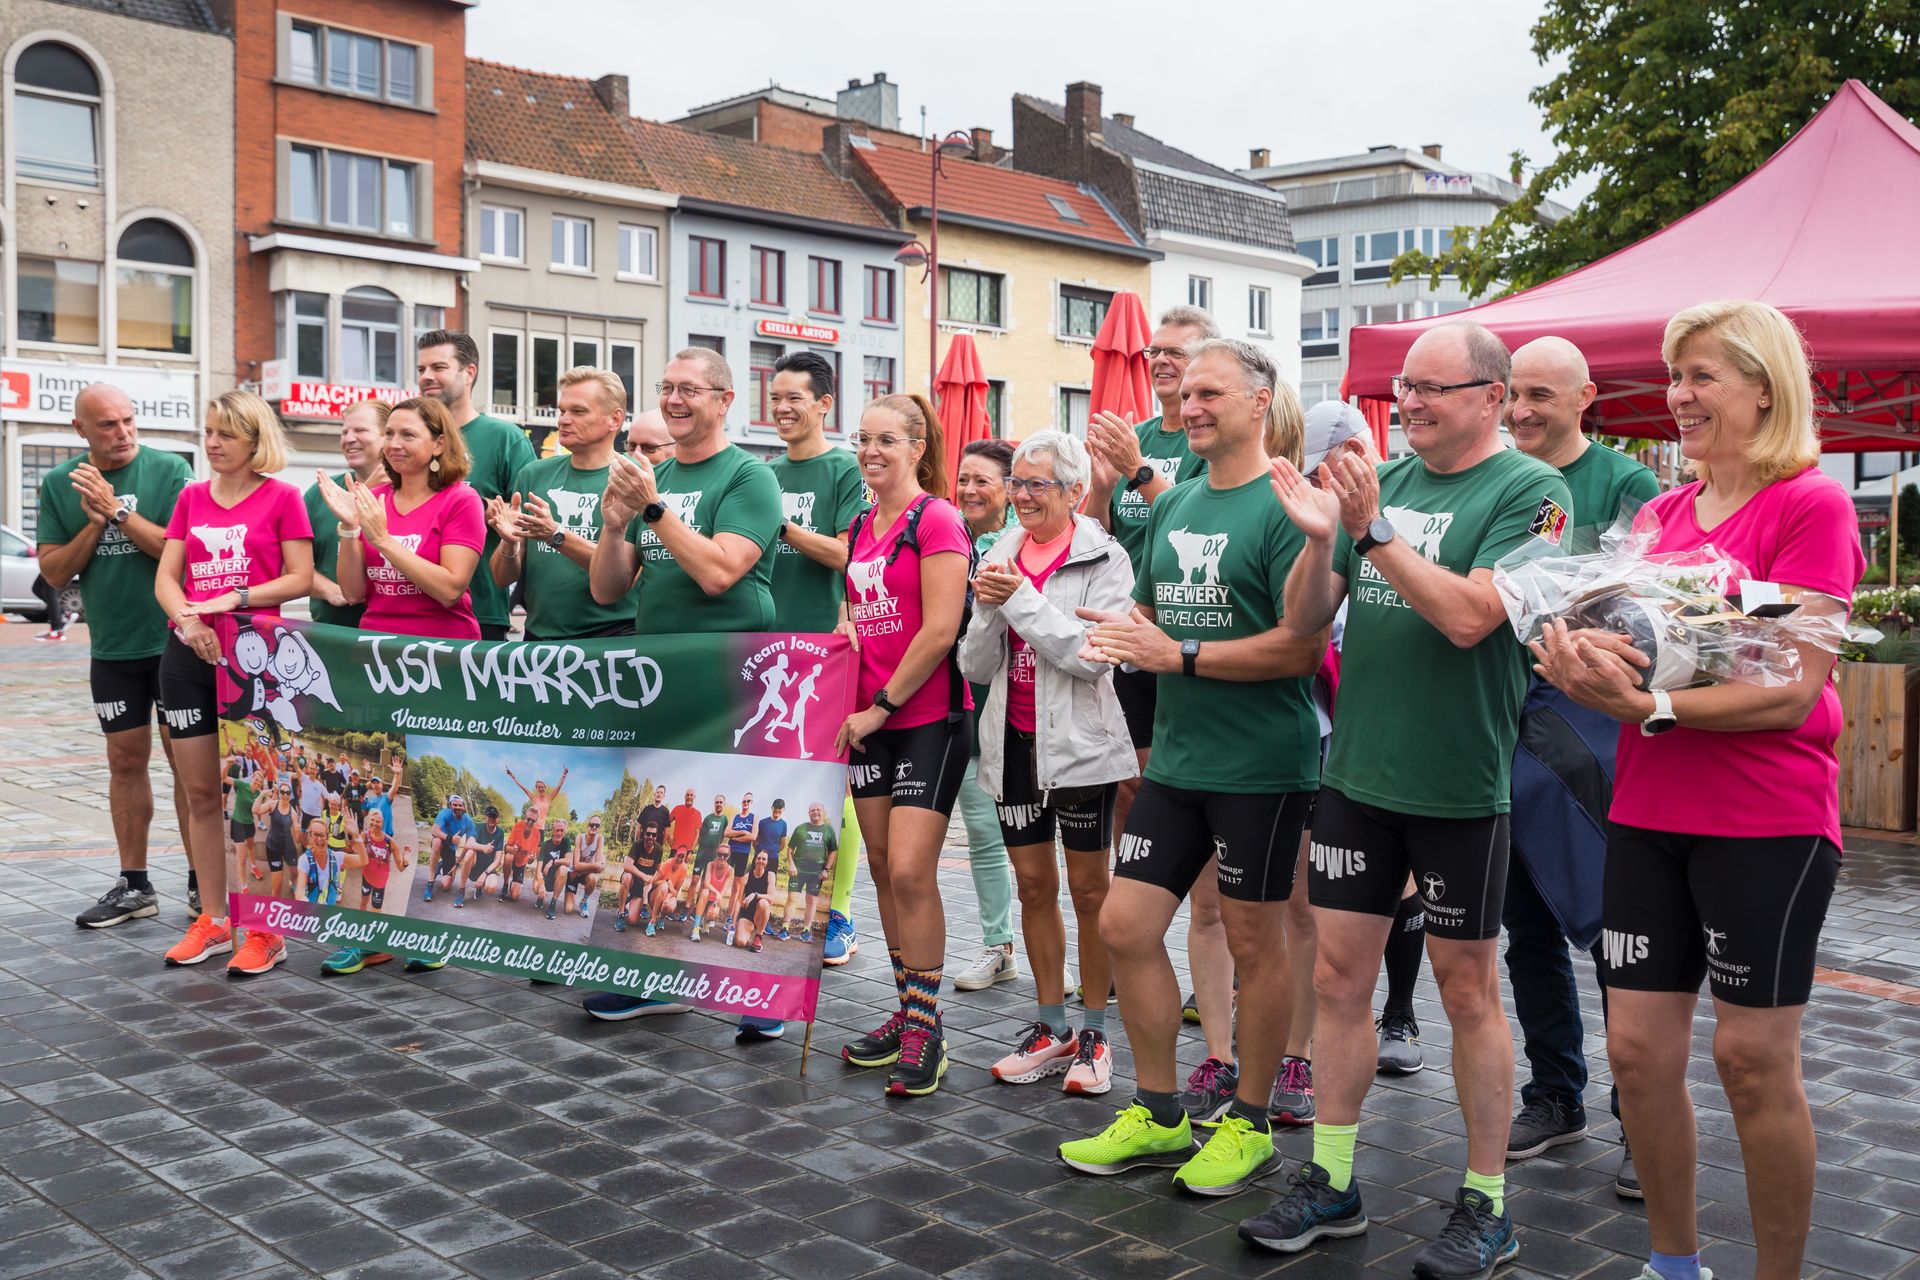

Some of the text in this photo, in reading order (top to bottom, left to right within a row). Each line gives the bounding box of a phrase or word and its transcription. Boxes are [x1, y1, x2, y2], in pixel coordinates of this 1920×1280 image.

[765, 322, 834, 340] STELLA ARTOIS
[38, 373, 104, 391] Imm
[299, 384, 372, 404] NACHT
[286, 401, 331, 415] TABAK
[1162, 460, 1179, 473] OX
[577, 496, 594, 508] OX
[681, 495, 699, 508] OX
[797, 496, 813, 508] OX
[225, 528, 243, 540] OX
[1422, 517, 1449, 535] OX
[1202, 539, 1225, 556] OX
[191, 559, 250, 577] BREWERY
[868, 561, 883, 578] OX
[193, 576, 250, 592] WEVELGEM
[1156, 585, 1229, 604] BREWERY
[1157, 609, 1232, 628] WEVELGEM
[856, 619, 904, 637] EVELGEM
[740, 636, 829, 681] #Team Joost
[358, 635, 663, 710] JUST MARRIED
[391, 708, 464, 734] Vanessa
[467, 719, 489, 734] en
[492, 716, 562, 739] Wouter
[571, 728, 636, 741] 28/08/2021
[997, 802, 1041, 830] BOWLS
[388, 929, 448, 955] wenst
[440, 934, 502, 964] jullie
[503, 945, 544, 969] alle
[546, 950, 610, 986] liefde
[612, 965, 642, 988] en
[643, 969, 712, 999] geluk
[714, 975, 781, 1010] toe!
